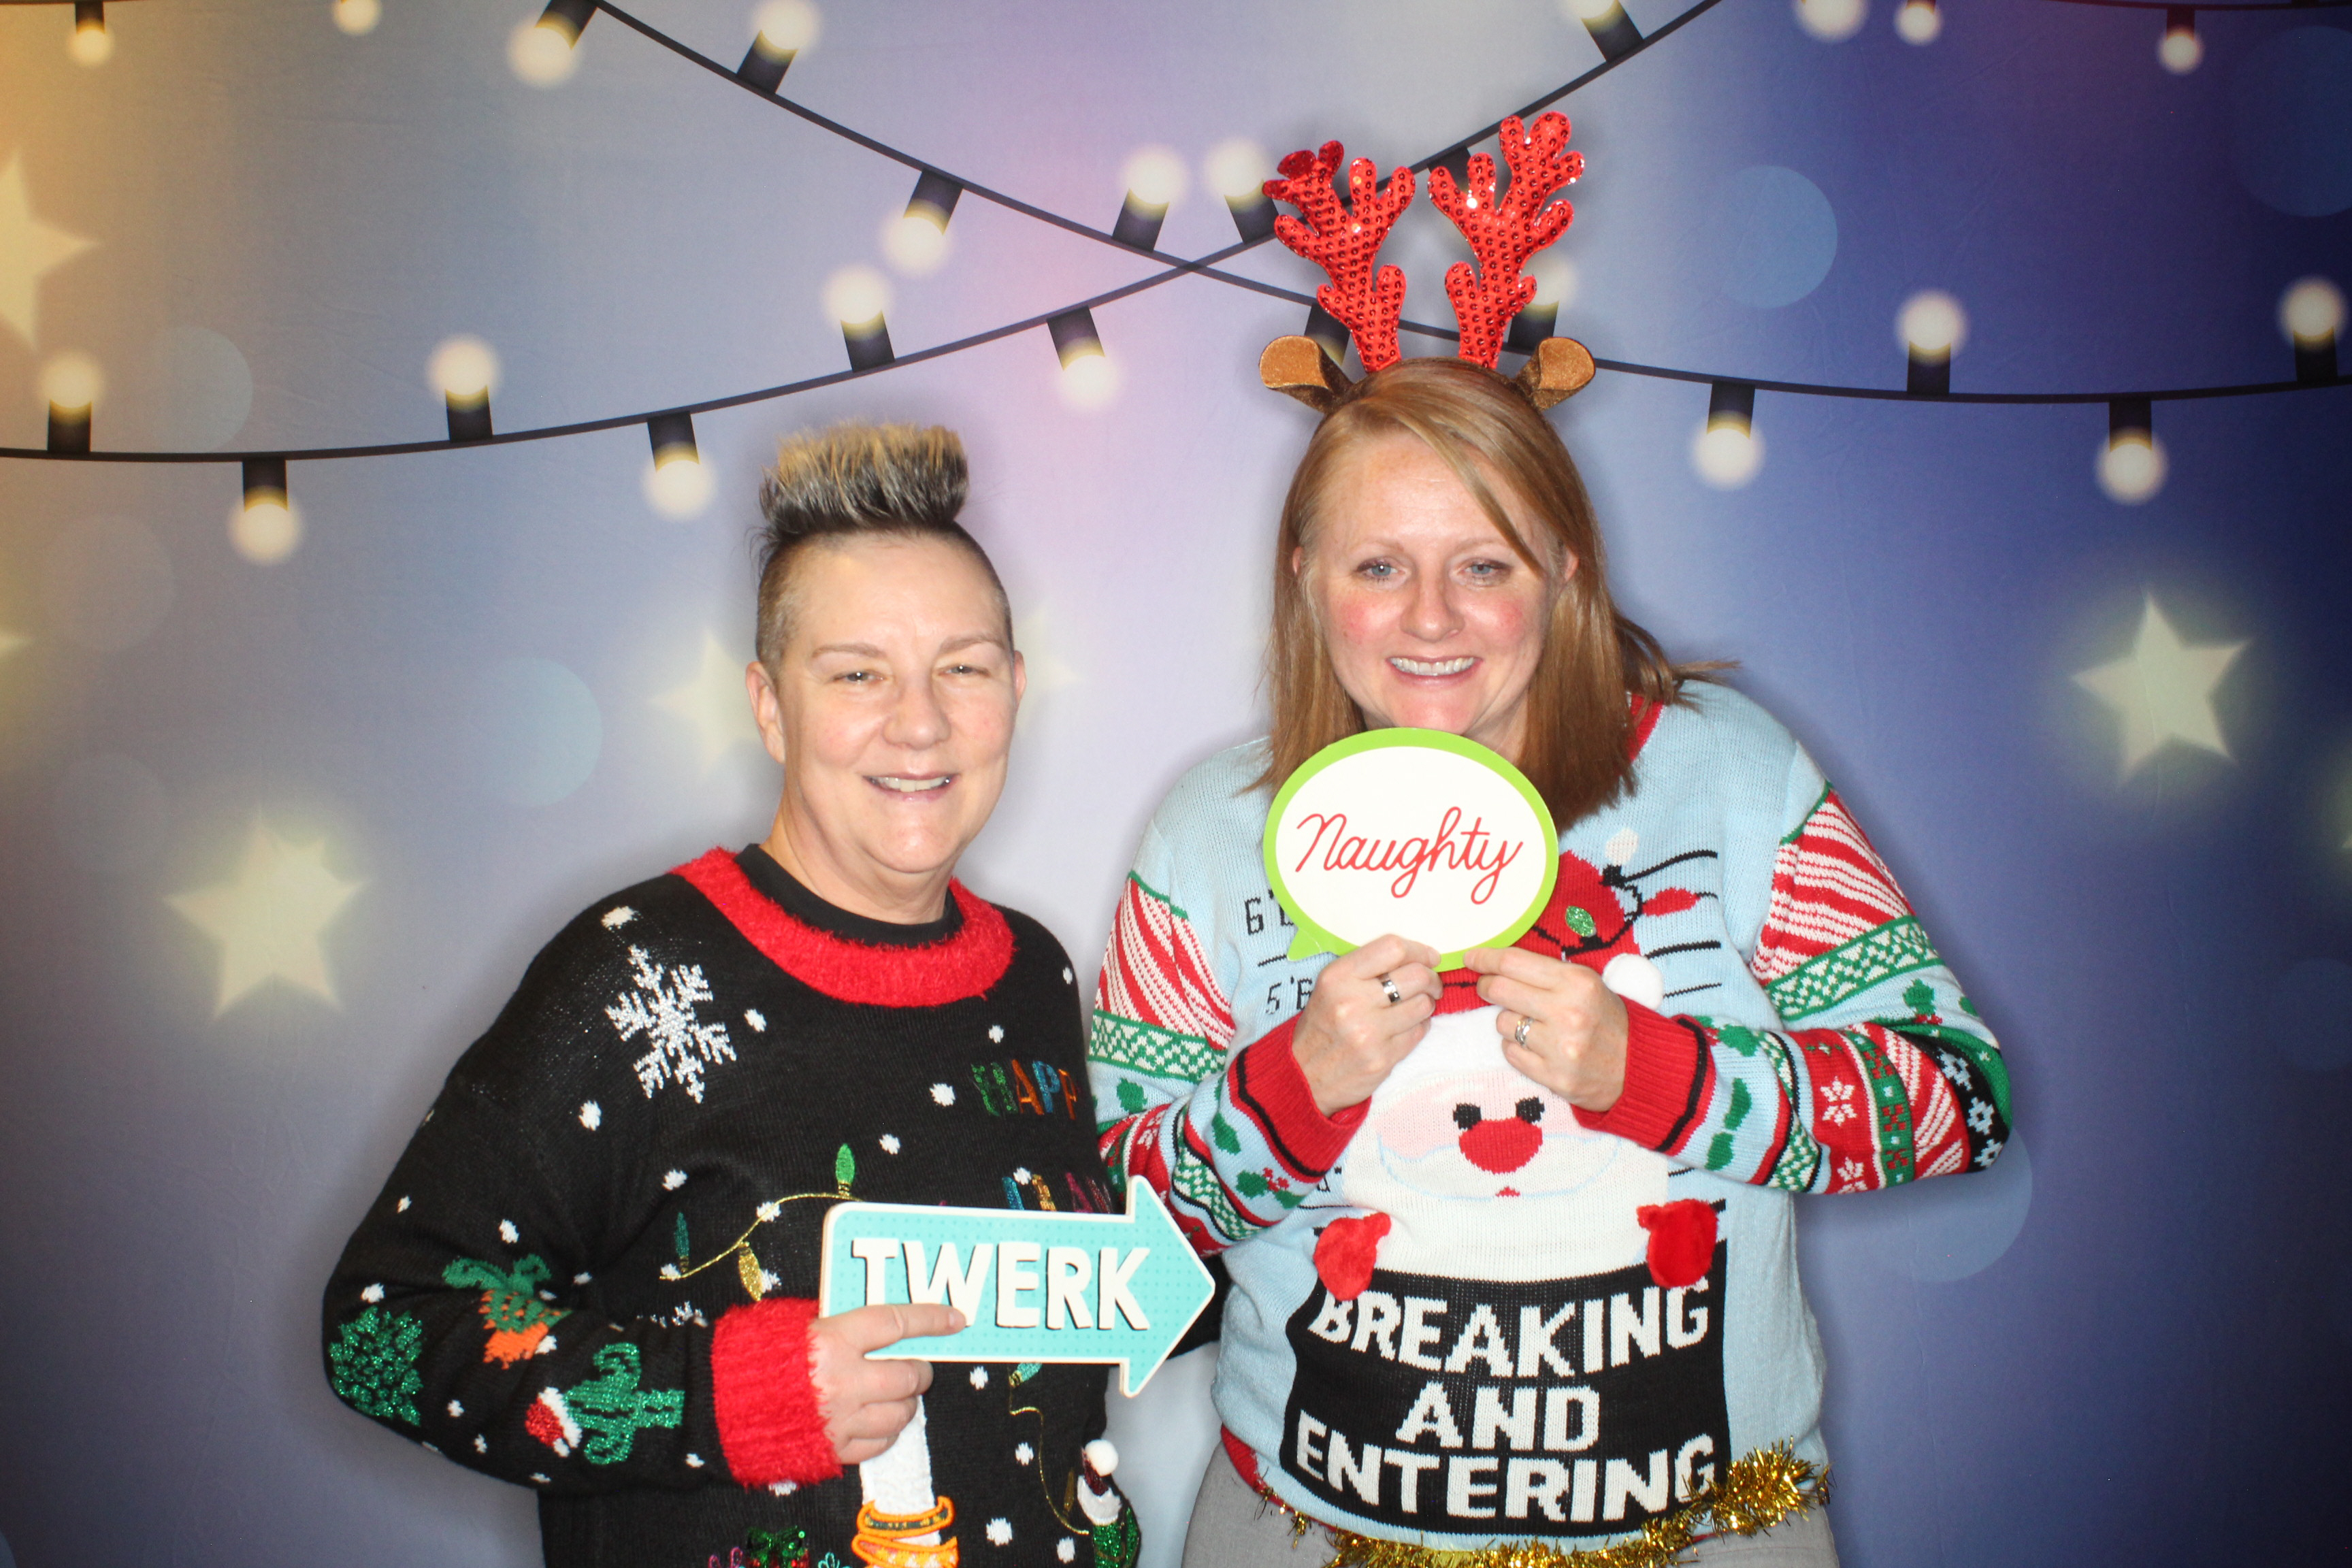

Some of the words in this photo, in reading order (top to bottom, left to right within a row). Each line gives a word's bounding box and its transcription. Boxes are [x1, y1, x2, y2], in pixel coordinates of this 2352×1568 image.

[1296, 806, 1524, 905] Naughty
[970, 1059, 1077, 1120] HAPP
[851, 1237, 1151, 1330] TWERK
[1308, 1279, 1710, 1378] BREAKING
[1395, 1382, 1601, 1452] AND
[1296, 1410, 1715, 1523] ENTERING
